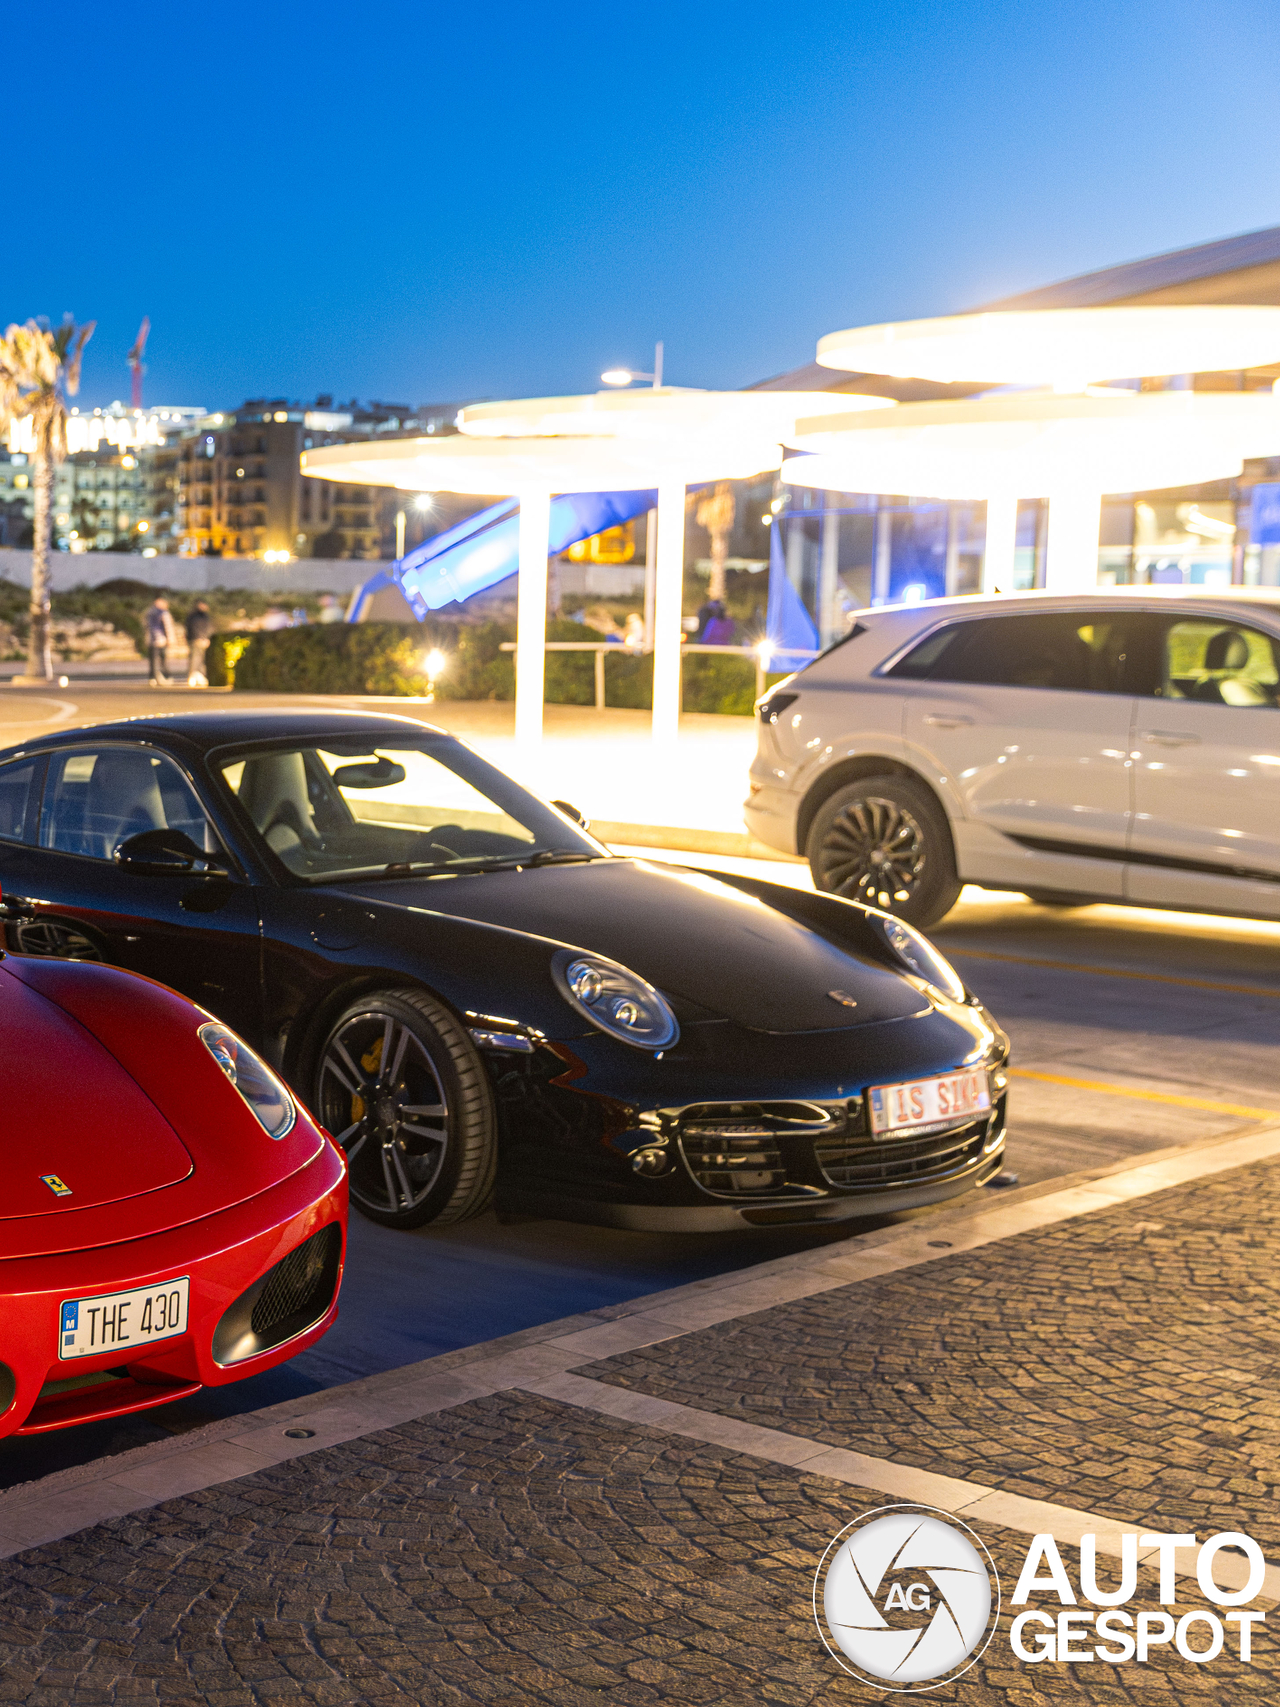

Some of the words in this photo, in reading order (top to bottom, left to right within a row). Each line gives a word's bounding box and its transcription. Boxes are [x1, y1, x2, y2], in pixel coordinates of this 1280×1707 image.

[65, 1319, 75, 1330] M
[86, 1301, 132, 1347] THE
[140, 1290, 180, 1335] 430
